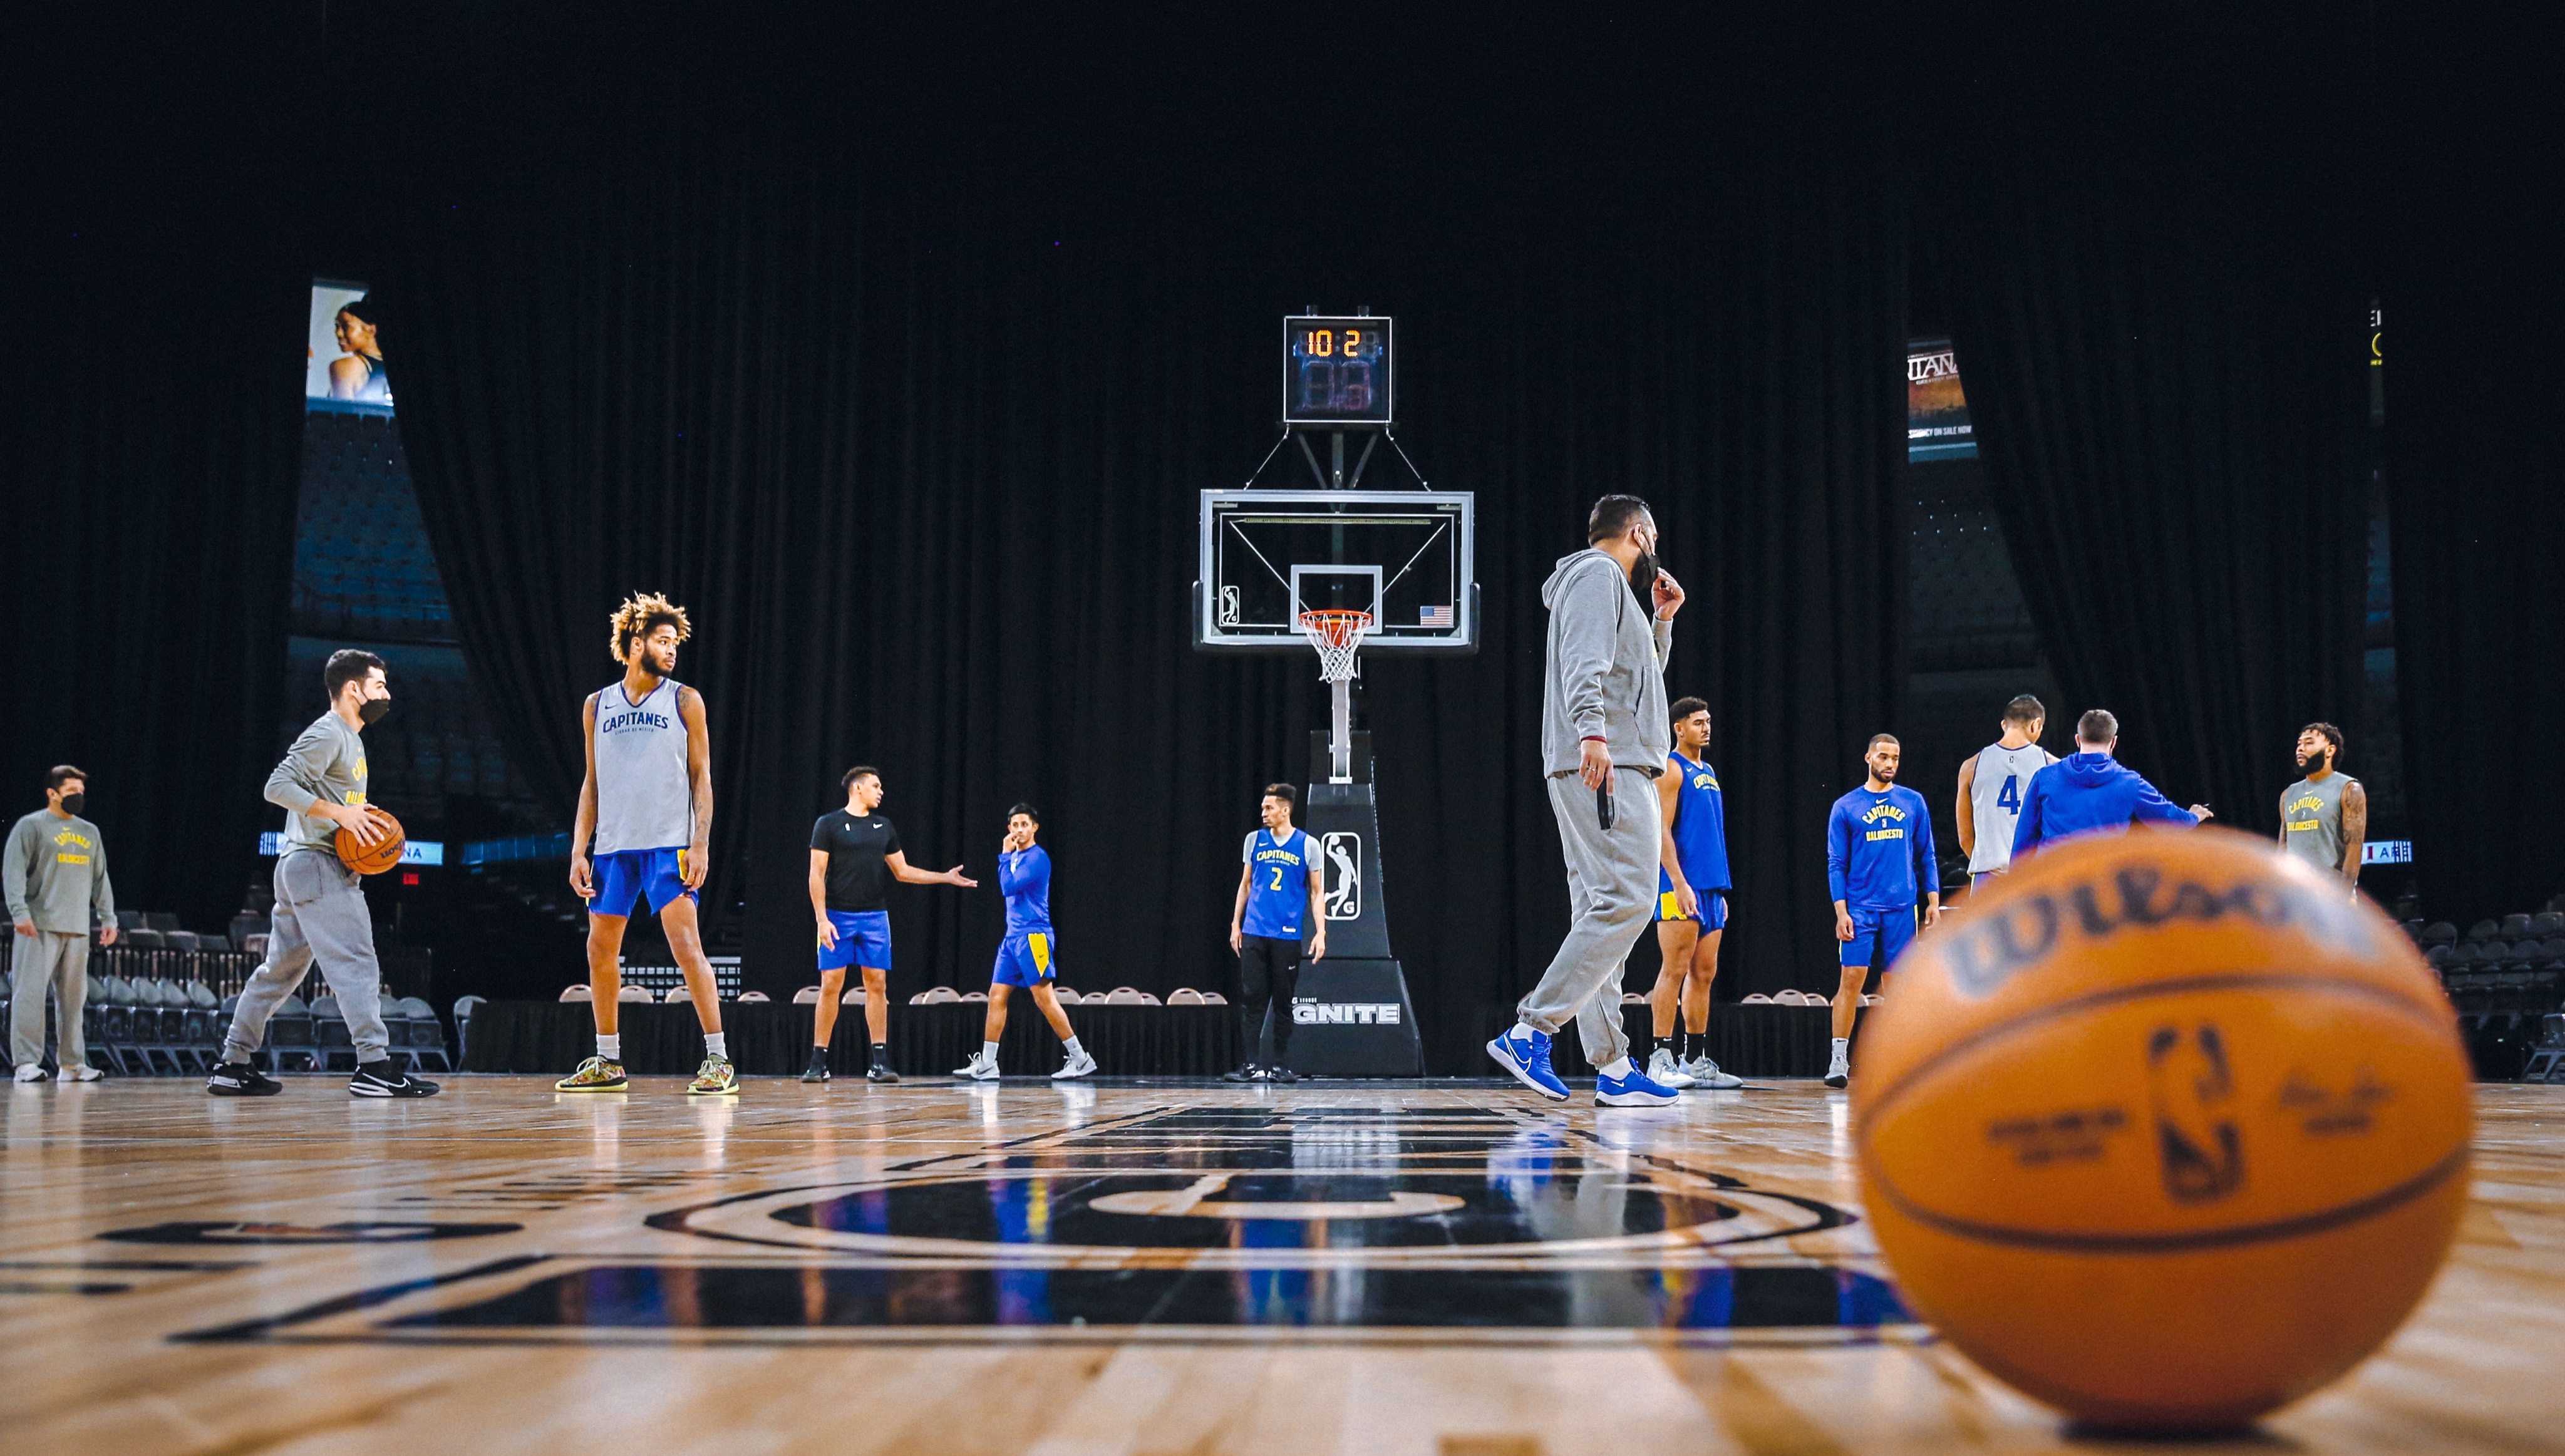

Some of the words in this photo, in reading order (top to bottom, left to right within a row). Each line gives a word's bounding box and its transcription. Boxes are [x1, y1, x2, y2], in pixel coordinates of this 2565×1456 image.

[1308, 330, 1332, 357] 10
[1344, 330, 1360, 357] 2
[603, 711, 668, 733] CAPITANES
[1997, 775, 2021, 815] 4
[1862, 805, 1906, 825] CAPITANES
[1866, 829, 1904, 842] BALONCESTO
[1257, 849, 1300, 866] CAPITANES
[1270, 867, 1282, 891] 2
[1343, 901, 1355, 914] G
[1292, 1003, 1400, 1025] GNITE
